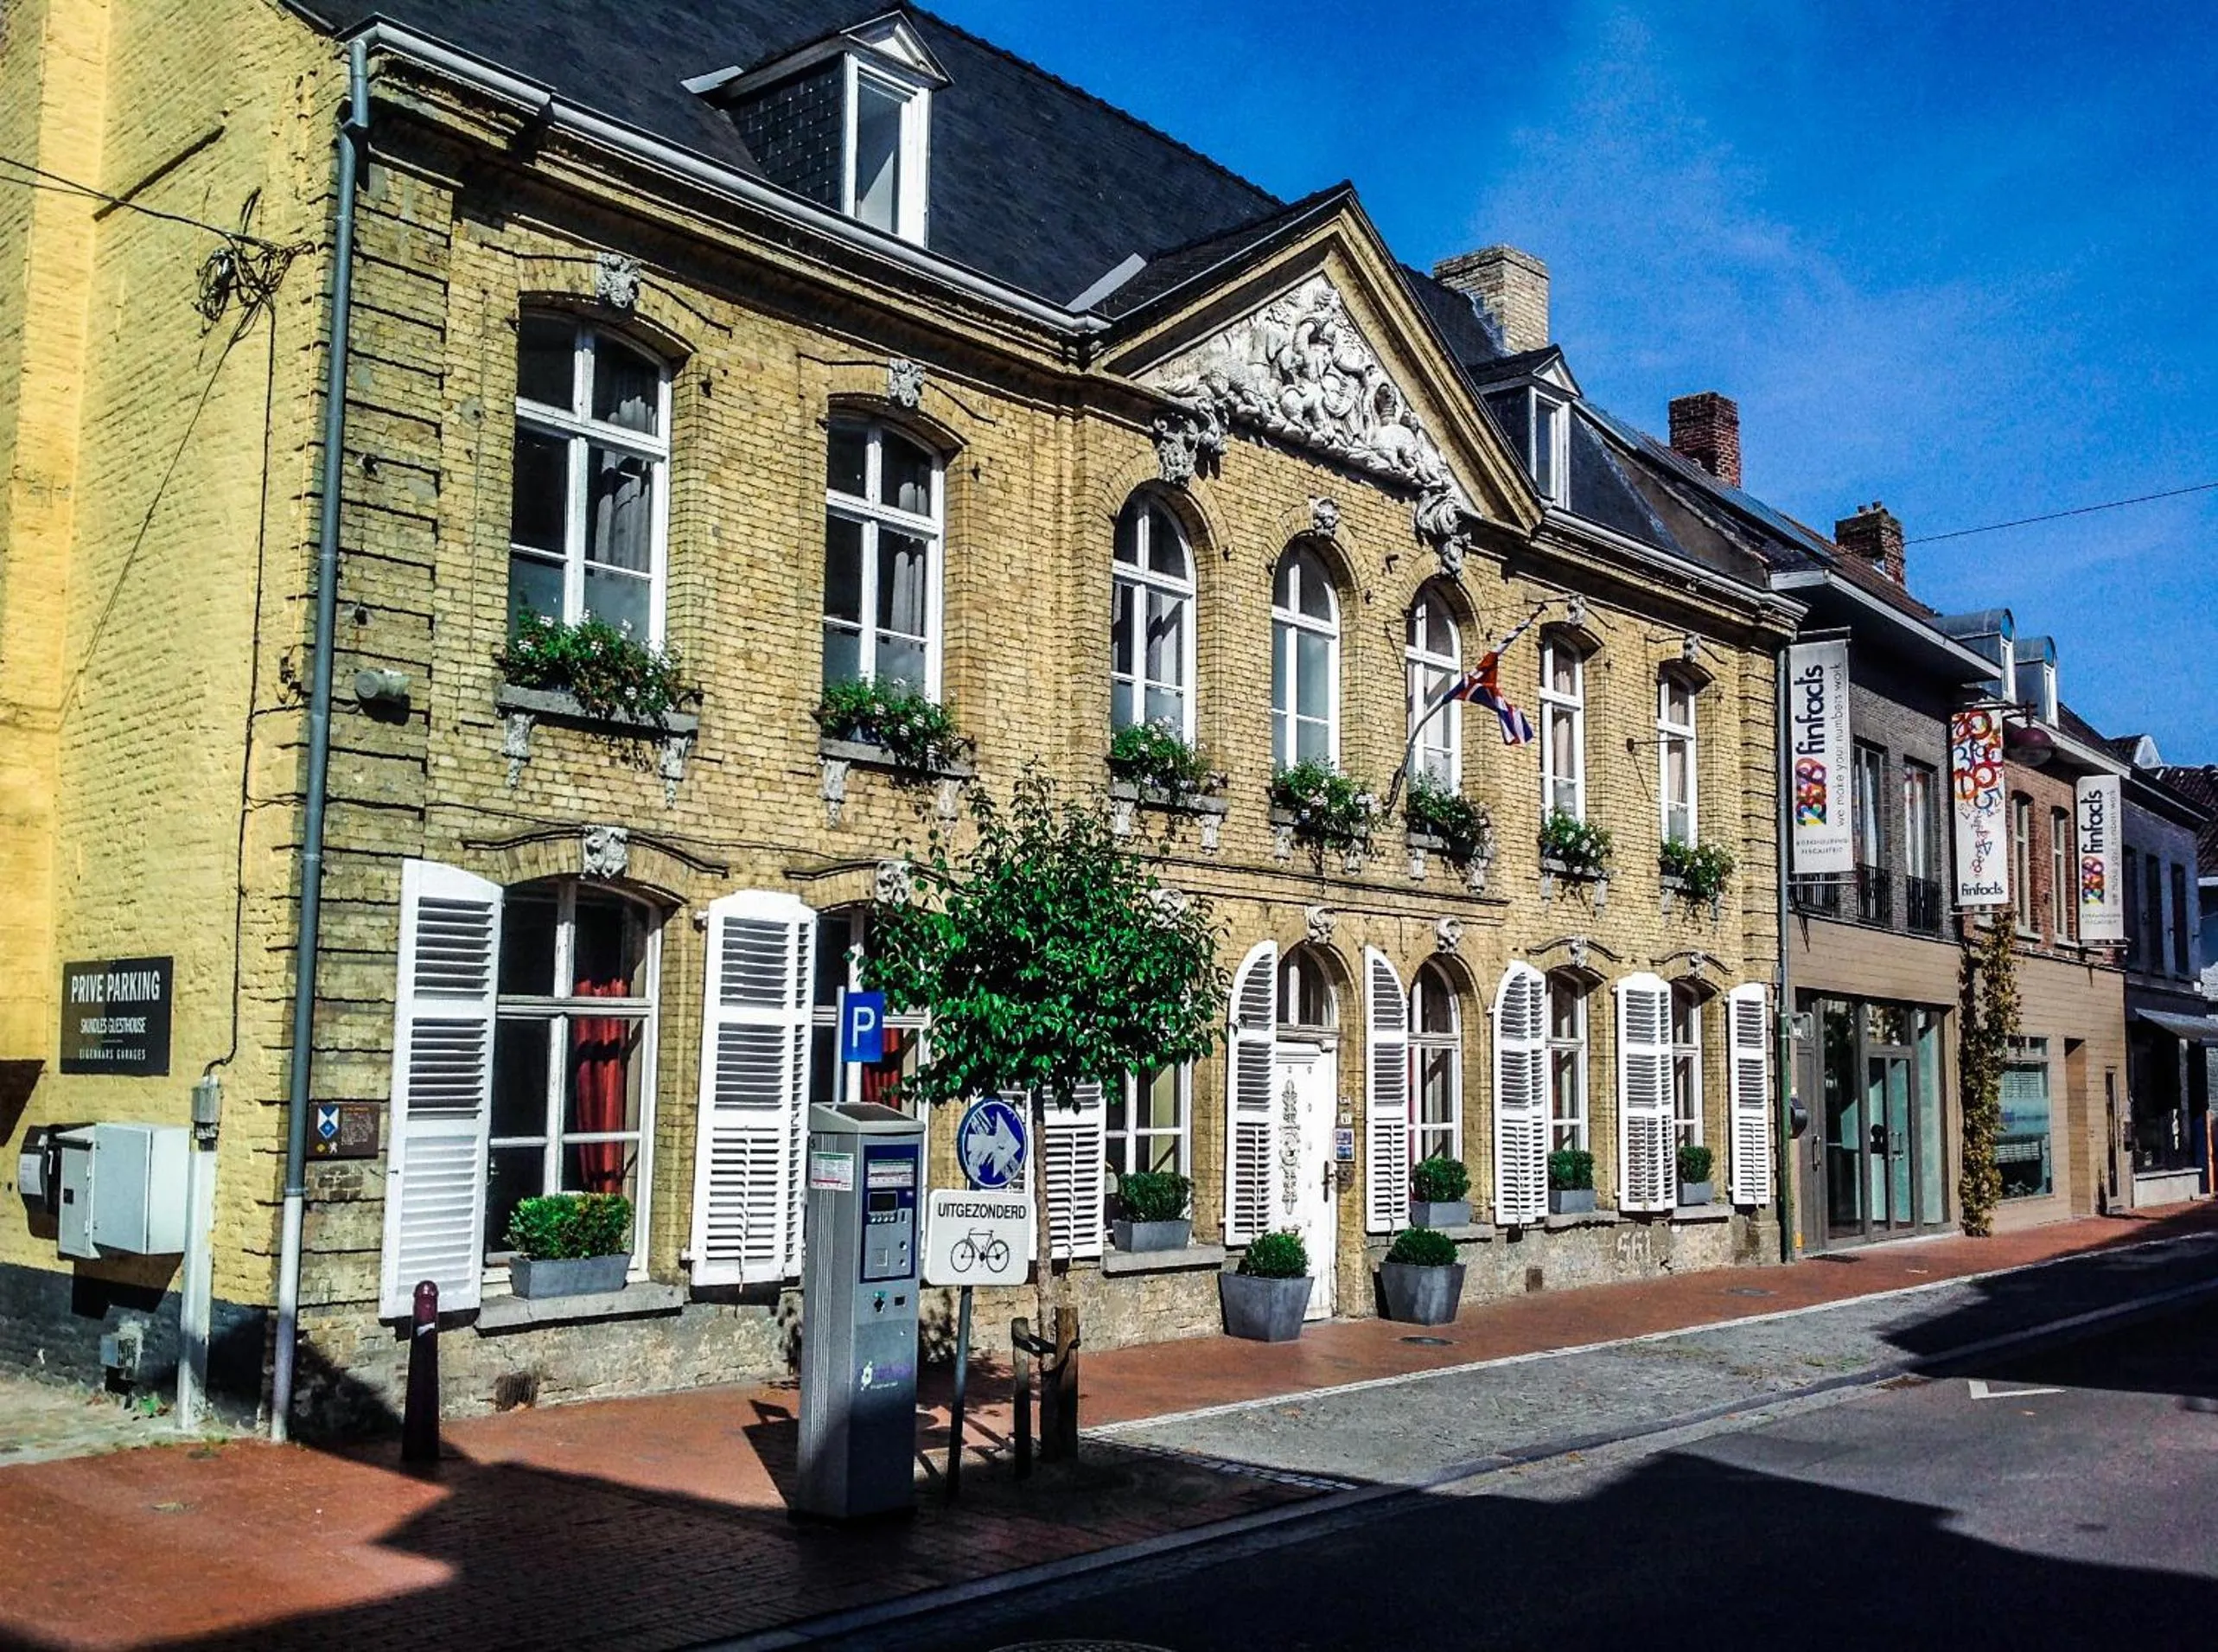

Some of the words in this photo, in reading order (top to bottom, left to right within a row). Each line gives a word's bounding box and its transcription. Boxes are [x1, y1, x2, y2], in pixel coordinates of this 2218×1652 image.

[1794, 664, 1826, 755] finfacts
[1831, 695, 1844, 742] numbers
[1835, 746, 1847, 770] your
[1832, 774, 1845, 806] make
[2079, 789, 2104, 854] finfacts
[1961, 881, 2004, 896] finfacts
[71, 973, 104, 1003] PRIVE
[106, 970, 161, 1002] PARKING
[852, 1006, 876, 1048] P
[938, 1202, 1027, 1219] UITGEZONDERD
